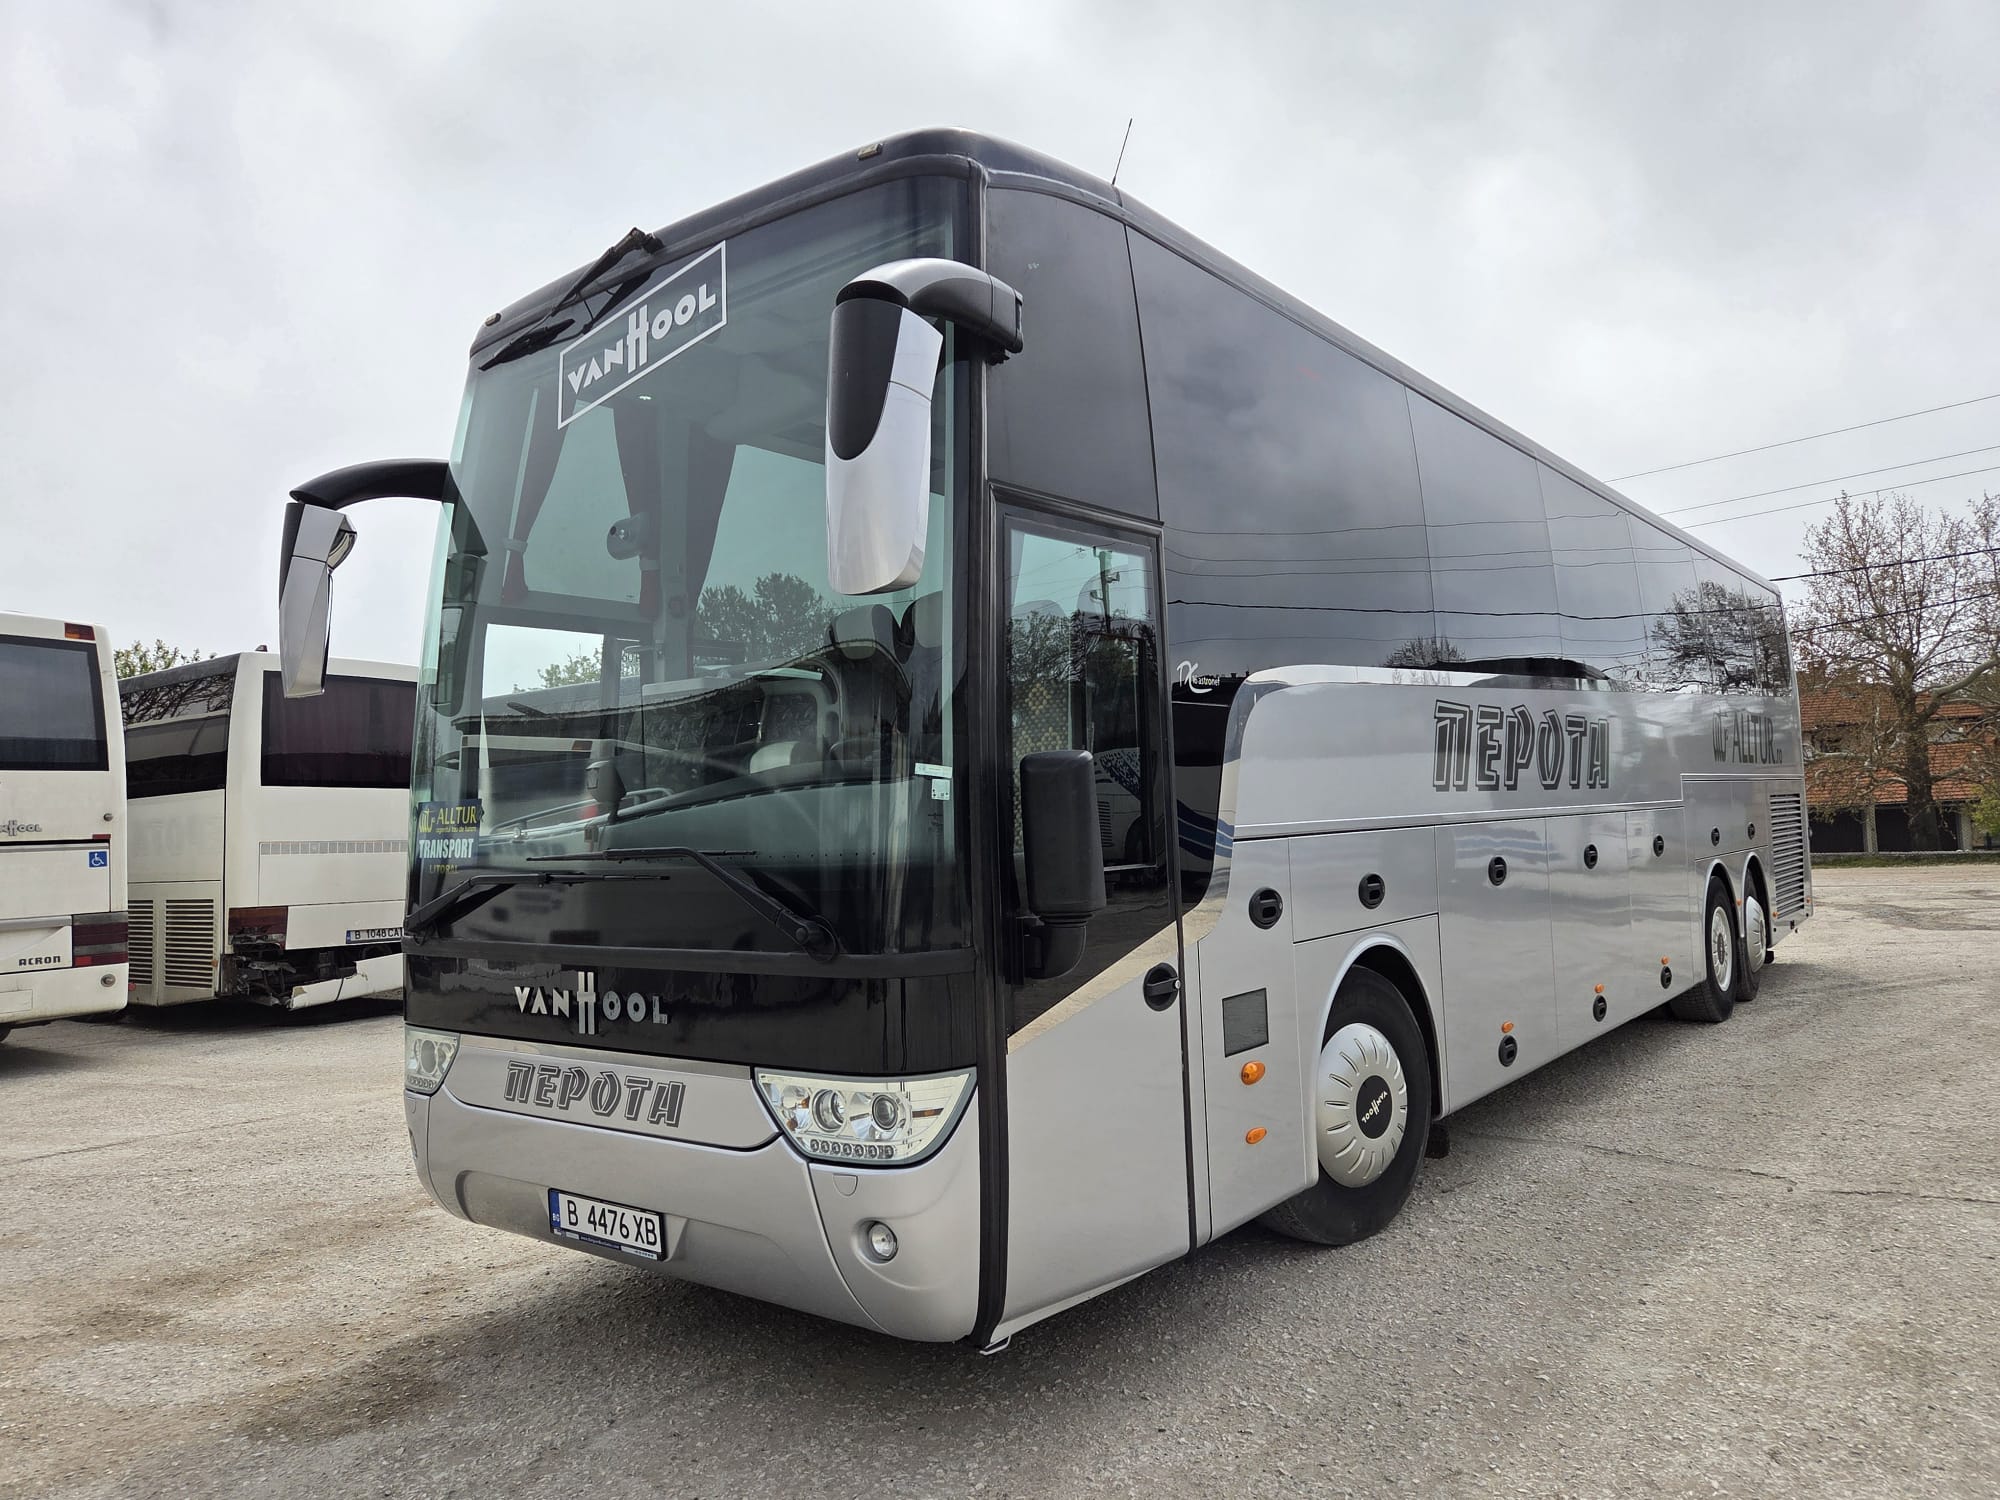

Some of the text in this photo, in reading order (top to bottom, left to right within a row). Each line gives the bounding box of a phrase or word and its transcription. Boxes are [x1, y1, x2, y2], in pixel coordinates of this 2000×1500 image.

[1433, 699, 1610, 792] ПЕРОТА
[437, 806, 477, 825] ALLTUR
[419, 838, 475, 859] TRANSPORT
[18, 955, 62, 967] ACRON
[504, 1060, 687, 1128] ПЕРОТА
[567, 1199, 579, 1227] B
[587, 1205, 630, 1240] 4476
